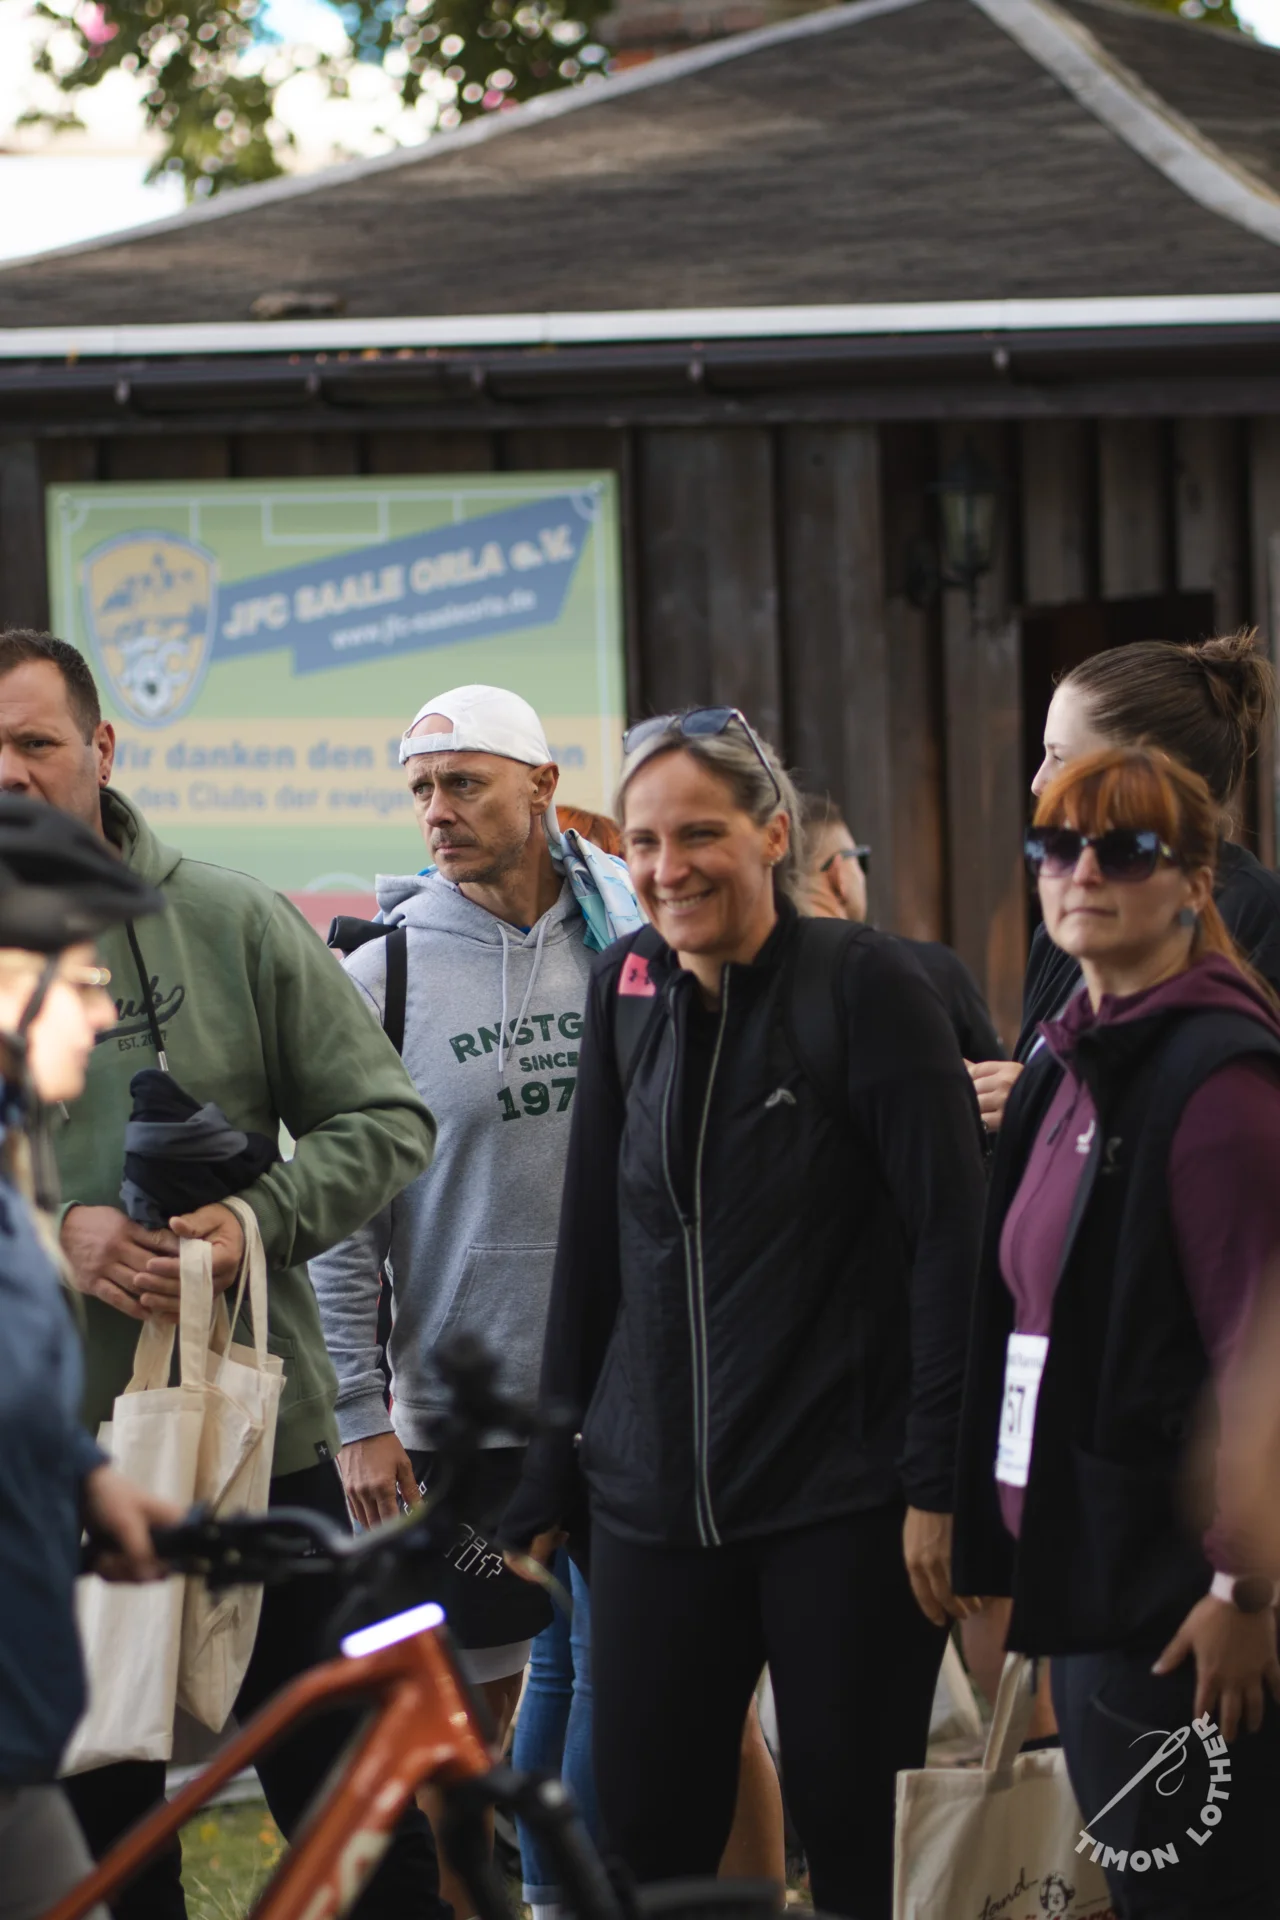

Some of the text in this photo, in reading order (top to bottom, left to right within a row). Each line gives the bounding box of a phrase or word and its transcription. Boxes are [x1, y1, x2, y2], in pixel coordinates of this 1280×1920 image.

[165, 738, 296, 769] danken
[307, 738, 374, 769] den
[519, 1051, 579, 1072] SINCE
